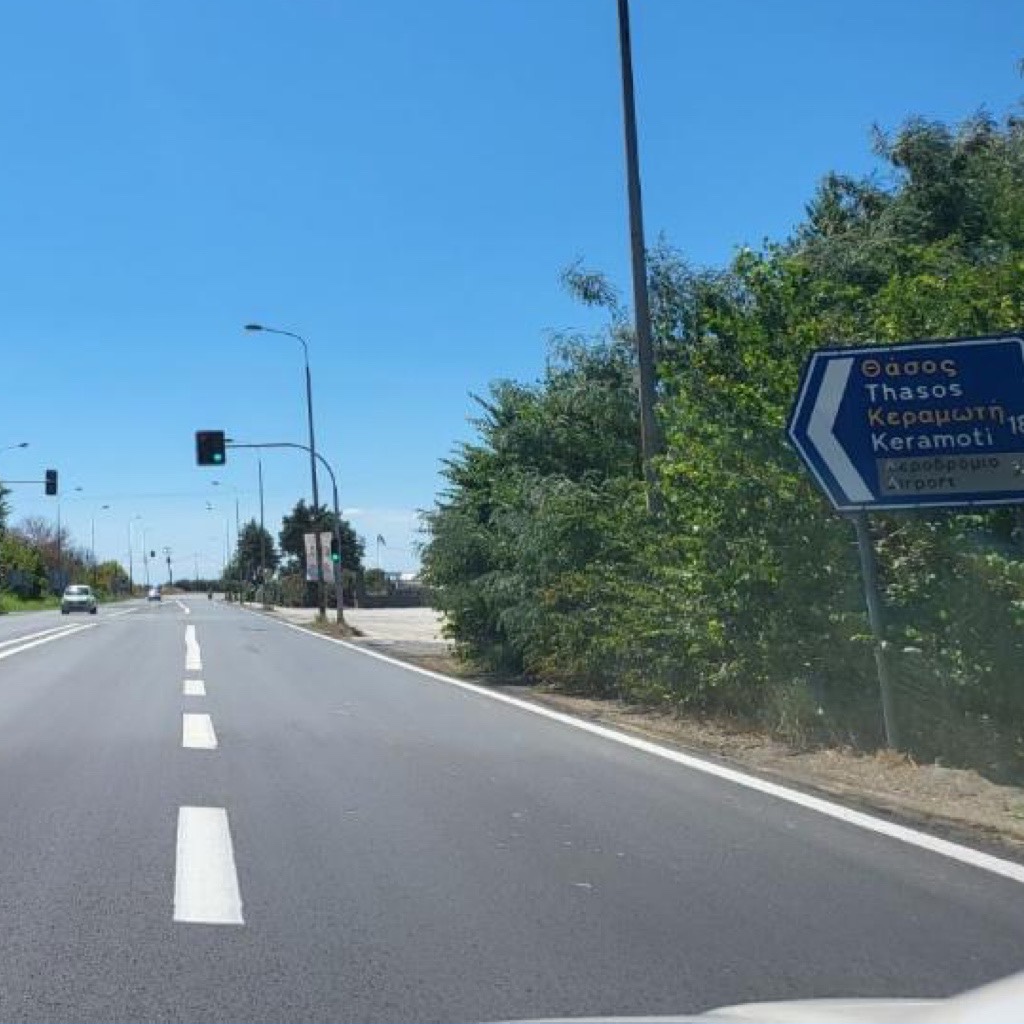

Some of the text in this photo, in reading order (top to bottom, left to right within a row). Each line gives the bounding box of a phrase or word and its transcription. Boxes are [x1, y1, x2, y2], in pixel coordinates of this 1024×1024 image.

[862, 357, 958, 378] Θάσος
[864, 384, 963, 402] Thasos
[869, 400, 1005, 428] Κεραμωτή
[872, 428, 993, 452] Keramoti
